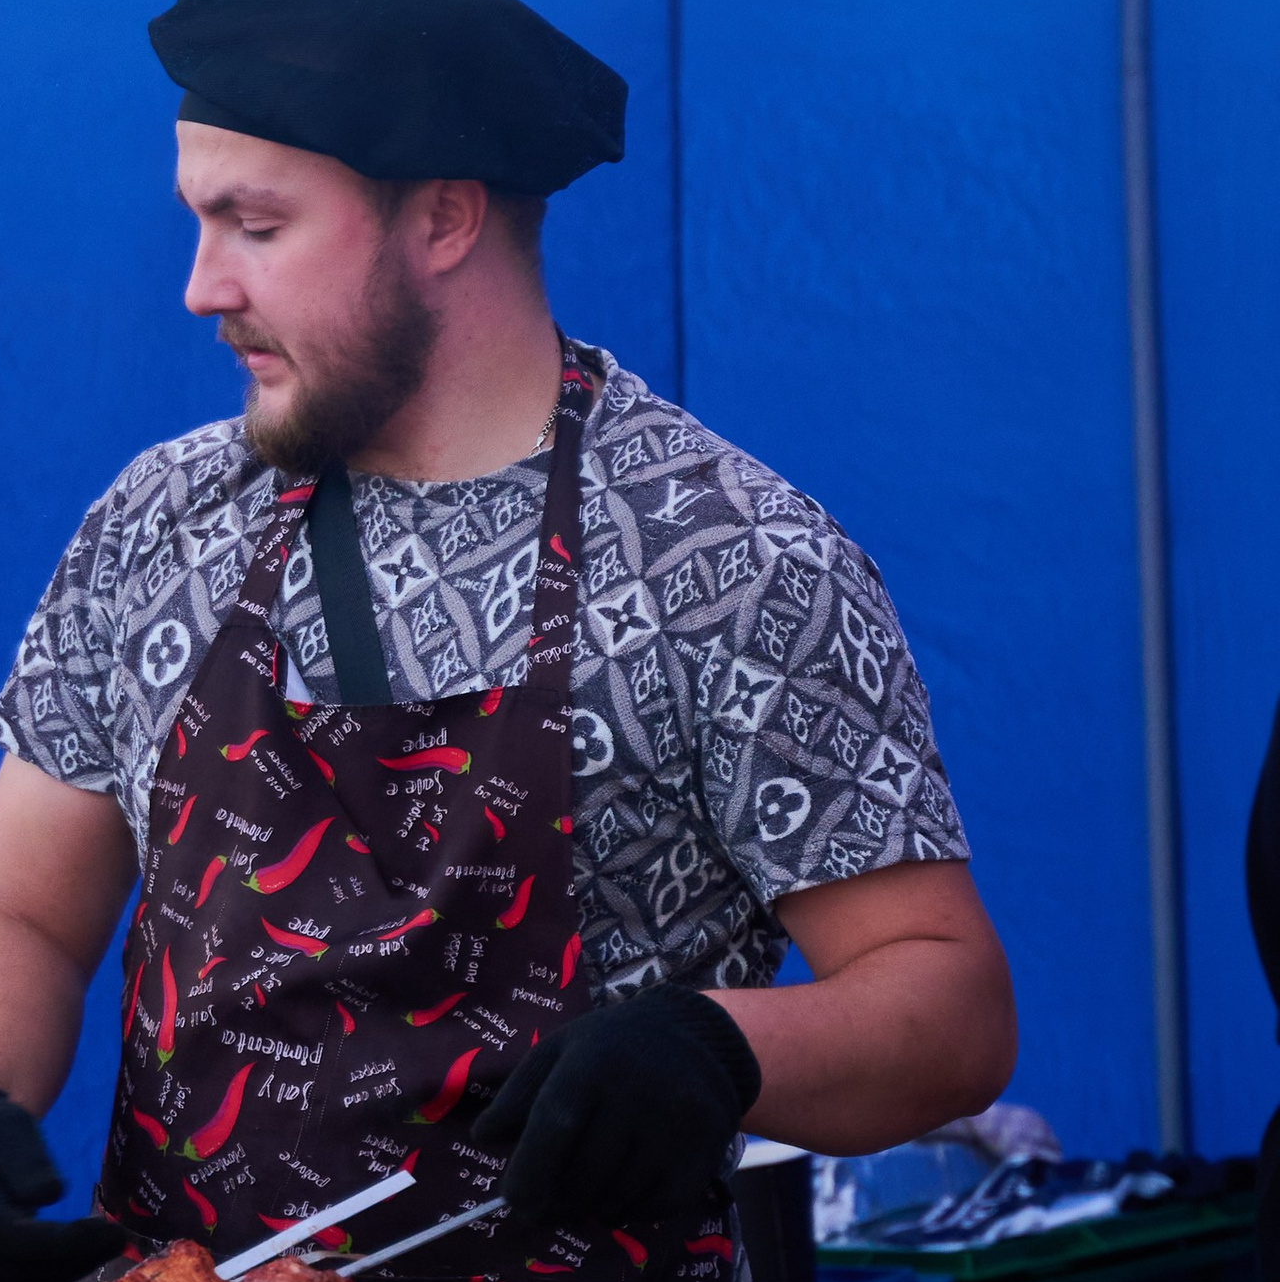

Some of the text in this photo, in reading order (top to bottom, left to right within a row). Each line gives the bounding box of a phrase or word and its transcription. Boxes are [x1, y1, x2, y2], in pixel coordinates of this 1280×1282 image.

[403, 727, 447, 752] pepe
[406, 770, 443, 795] Sale
[289, 917, 331, 939] pepe
[470, 1007, 517, 1040] pepper
[222, 1030, 323, 1066] pimienta
[351, 1059, 395, 1082] pepper
[258, 1074, 314, 1110] Sal y
[279, 1152, 331, 1187] poivre
